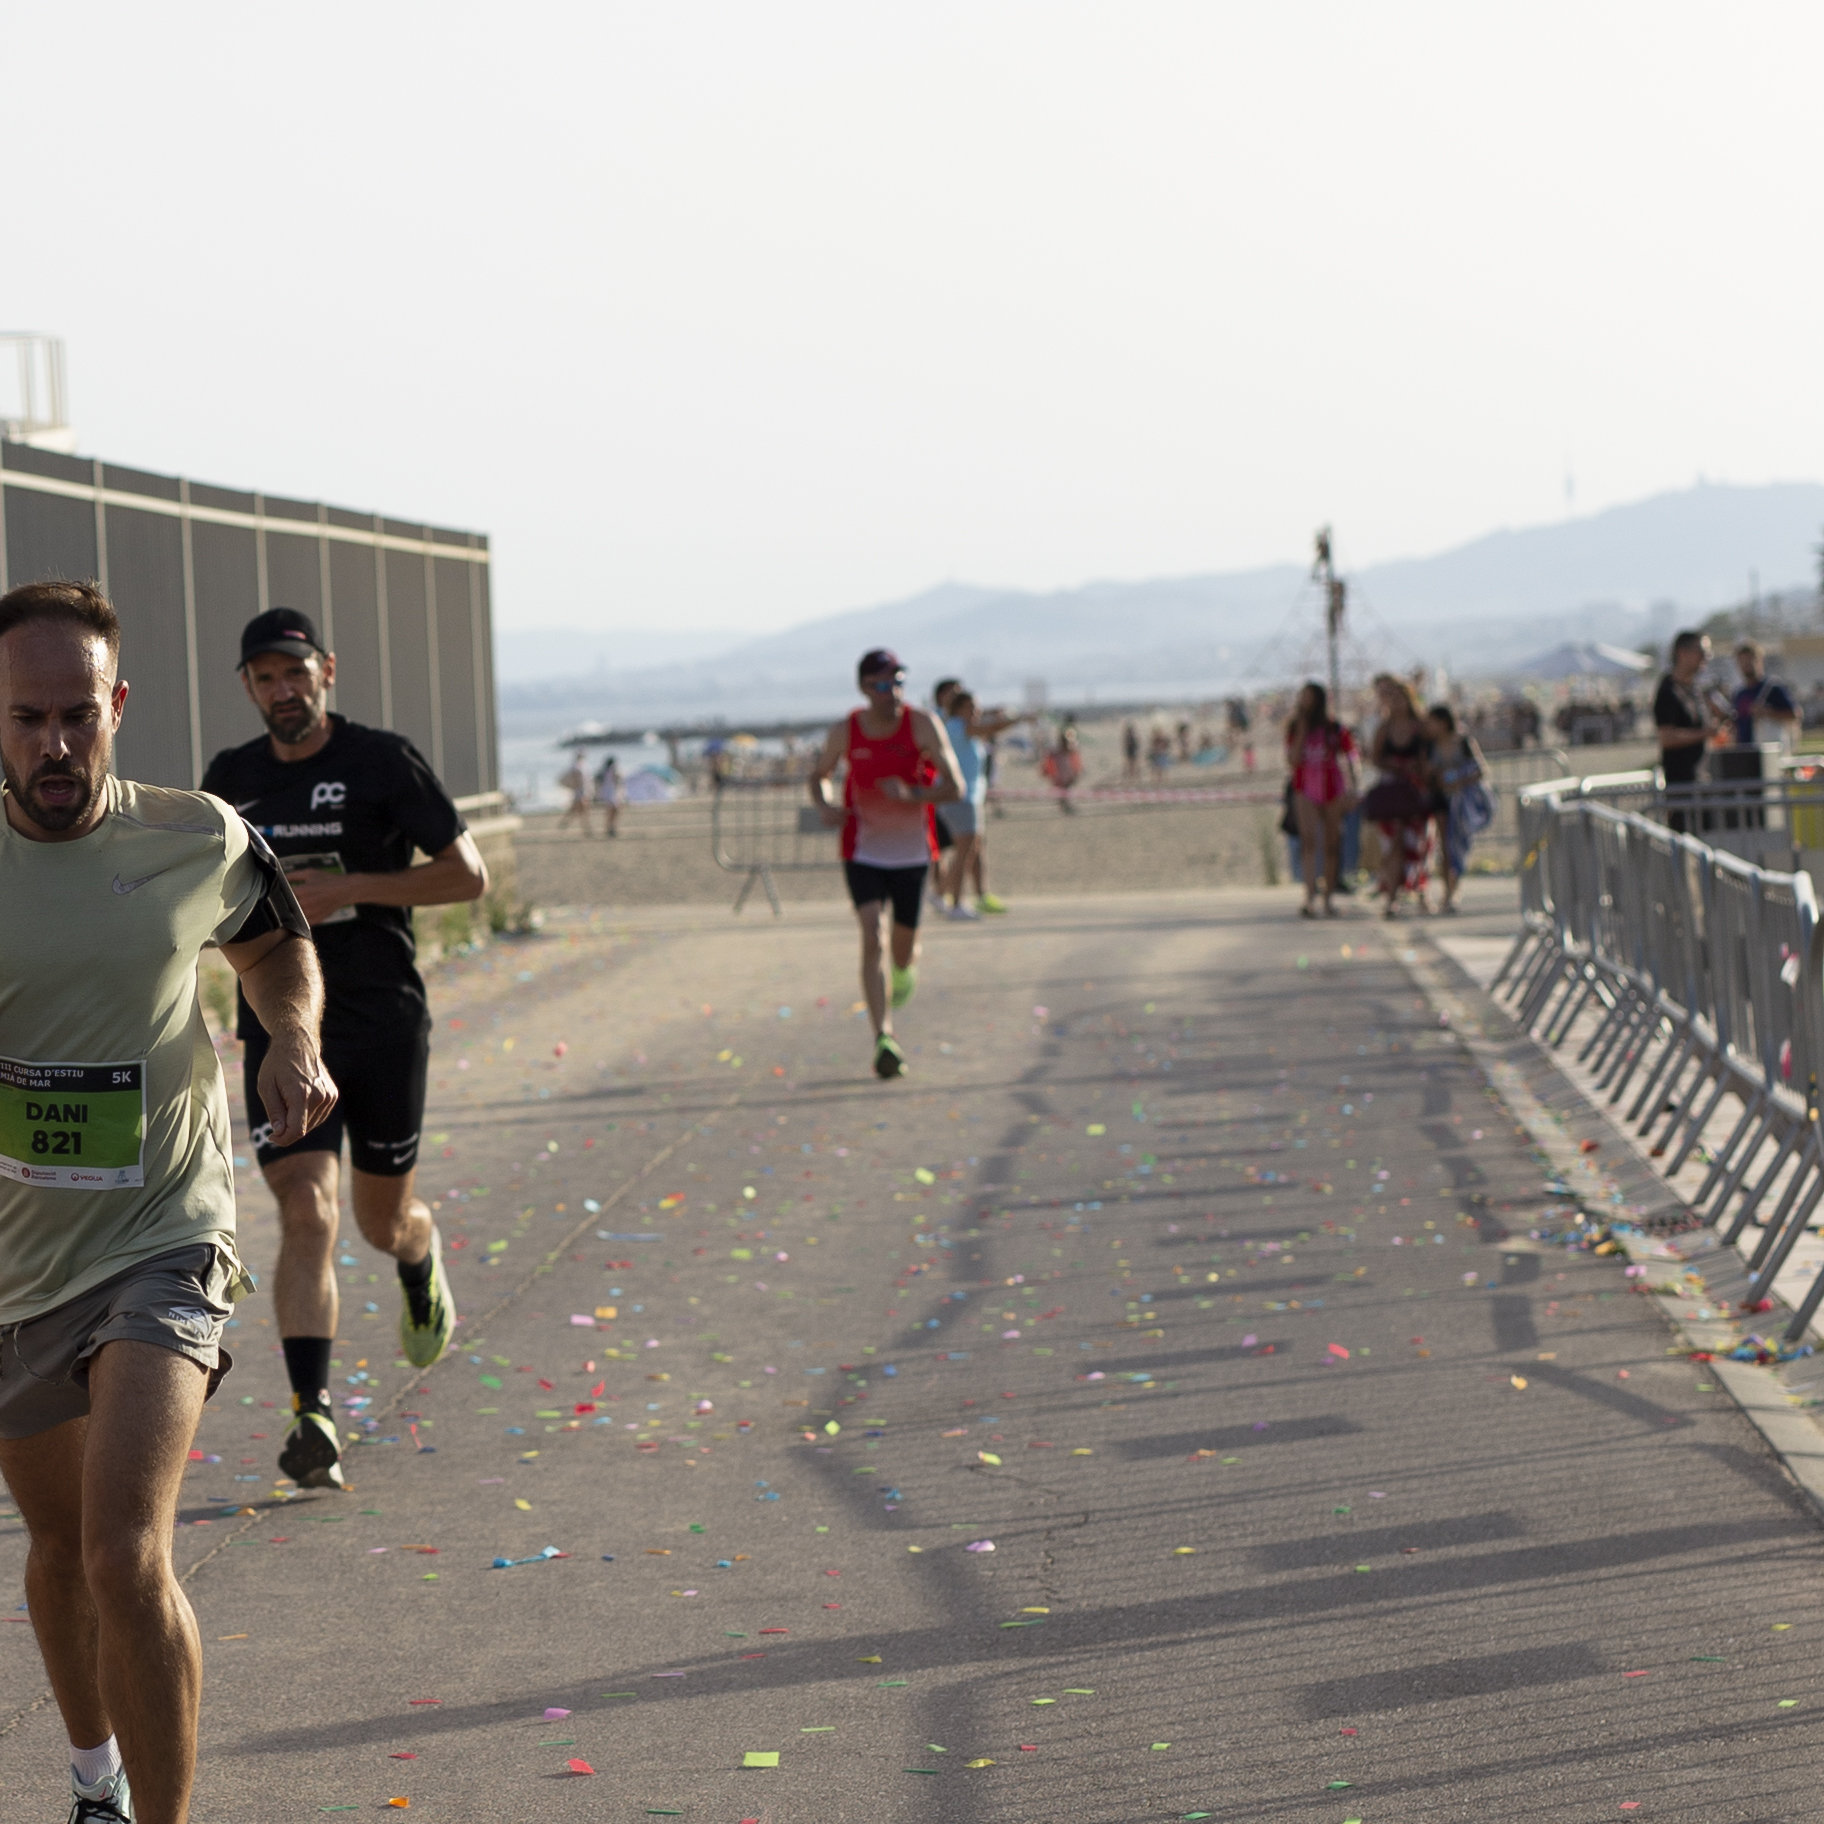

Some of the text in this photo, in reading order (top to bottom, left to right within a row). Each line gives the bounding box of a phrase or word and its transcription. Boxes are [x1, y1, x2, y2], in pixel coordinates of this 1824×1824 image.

[257, 821, 343, 837] RUNNING
[14, 1065, 42, 1077] CURSA
[45, 1069, 84, 1078] D'ESTIU
[112, 1071, 132, 1084] 5K
[16, 1076, 28, 1086] DE
[29, 1079, 51, 1087] MAR
[26, 1102, 88, 1124] DANI
[31, 1129, 82, 1155] 821
